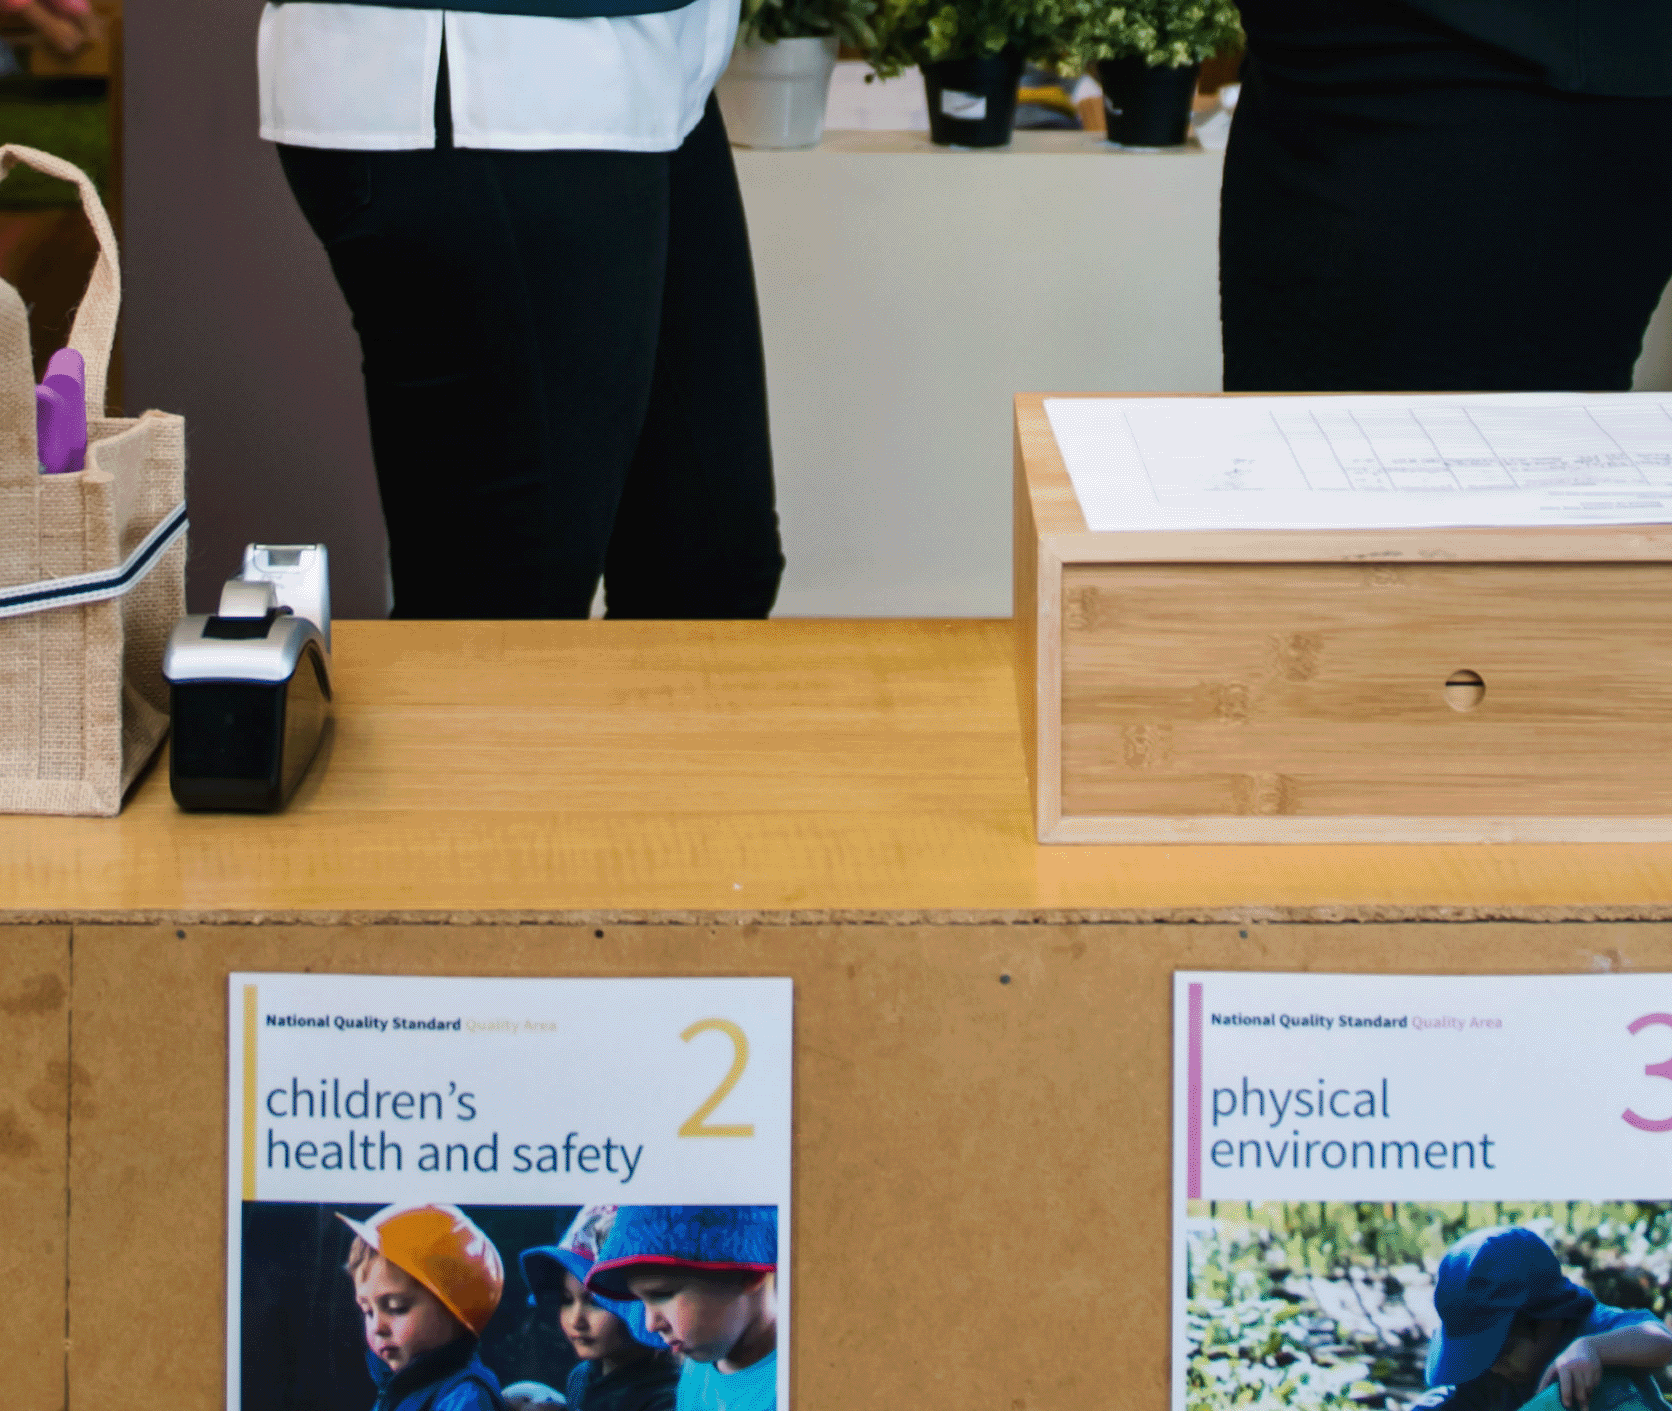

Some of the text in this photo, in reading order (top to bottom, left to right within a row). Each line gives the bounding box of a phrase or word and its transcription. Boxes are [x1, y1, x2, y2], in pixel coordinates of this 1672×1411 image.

[1212, 1014, 1277, 1027] National
[1280, 1015, 1335, 1031] Quality
[1340, 1016, 1409, 1029] Standard
[1411, 1016, 1466, 1031] Quality
[1470, 1018, 1504, 1029] Area
[266, 1015, 756, 1140] National Quality Standard Quality Area 2
[1213, 1077, 1391, 1129] physical
[268, 1129, 645, 1185] health and safety
[1211, 1130, 1496, 1171] environment
